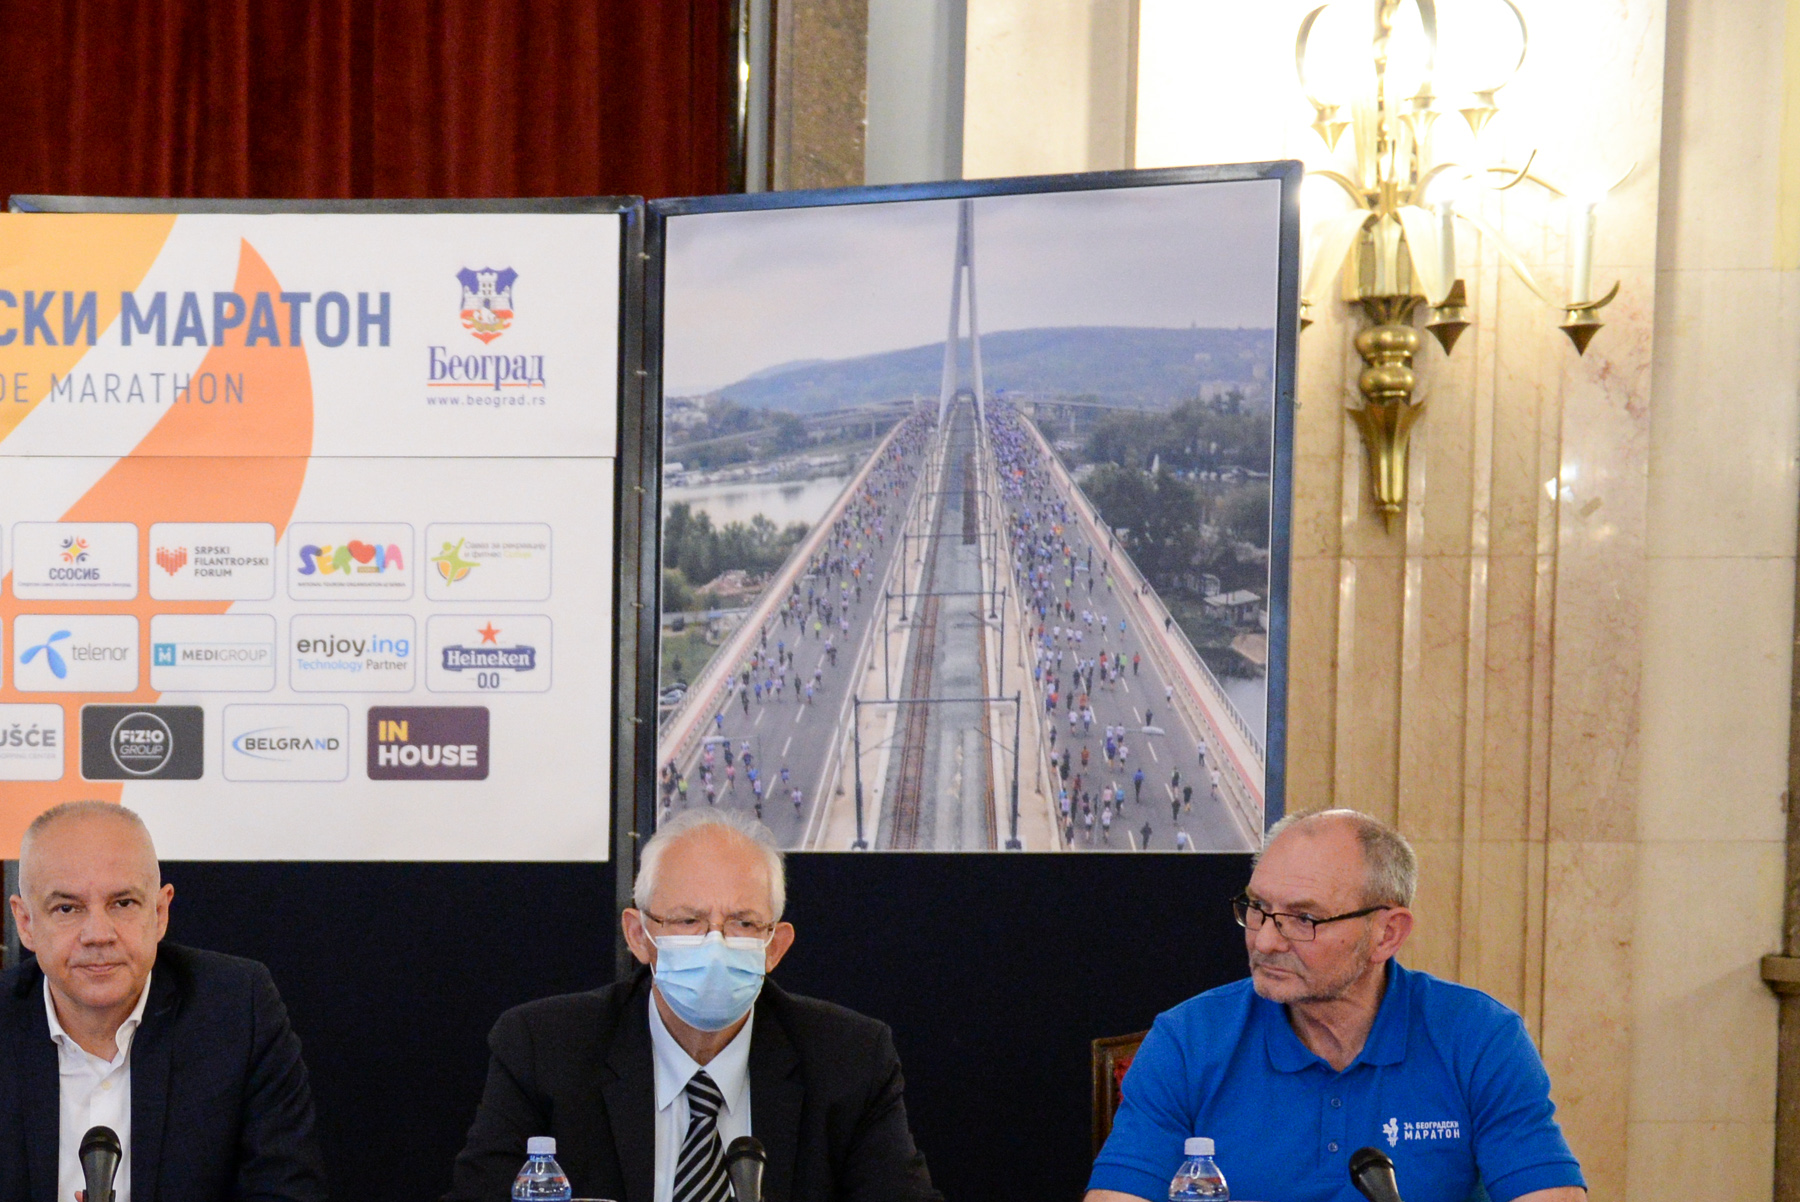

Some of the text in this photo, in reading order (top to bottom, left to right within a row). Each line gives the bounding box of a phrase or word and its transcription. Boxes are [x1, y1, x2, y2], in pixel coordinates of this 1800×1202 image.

[120, 291, 391, 347] МАРАТОН
[427, 345, 546, 391] Београд
[50, 373, 245, 404] MARATHON
[426, 394, 546, 408] www.beograd.rs
[194, 546, 230, 555] SRPSKI
[194, 557, 269, 566] FILANTROPSKI
[49, 568, 100, 580] ССОСИБ
[194, 568, 232, 577] FORUM
[72, 643, 129, 661] telenor
[297, 634, 409, 657] enjoy.ing
[182, 649, 267, 661] MEDIGROUP
[447, 649, 530, 666] Heineken
[297, 659, 407, 672] Technology Partner
[378, 720, 408, 742] IN
[120, 744, 164, 755] GROUP
[245, 738, 340, 750] BELGRAND
[378, 745, 478, 767] HOUSE
[1404, 1129, 1460, 1140] МАРАТОН
